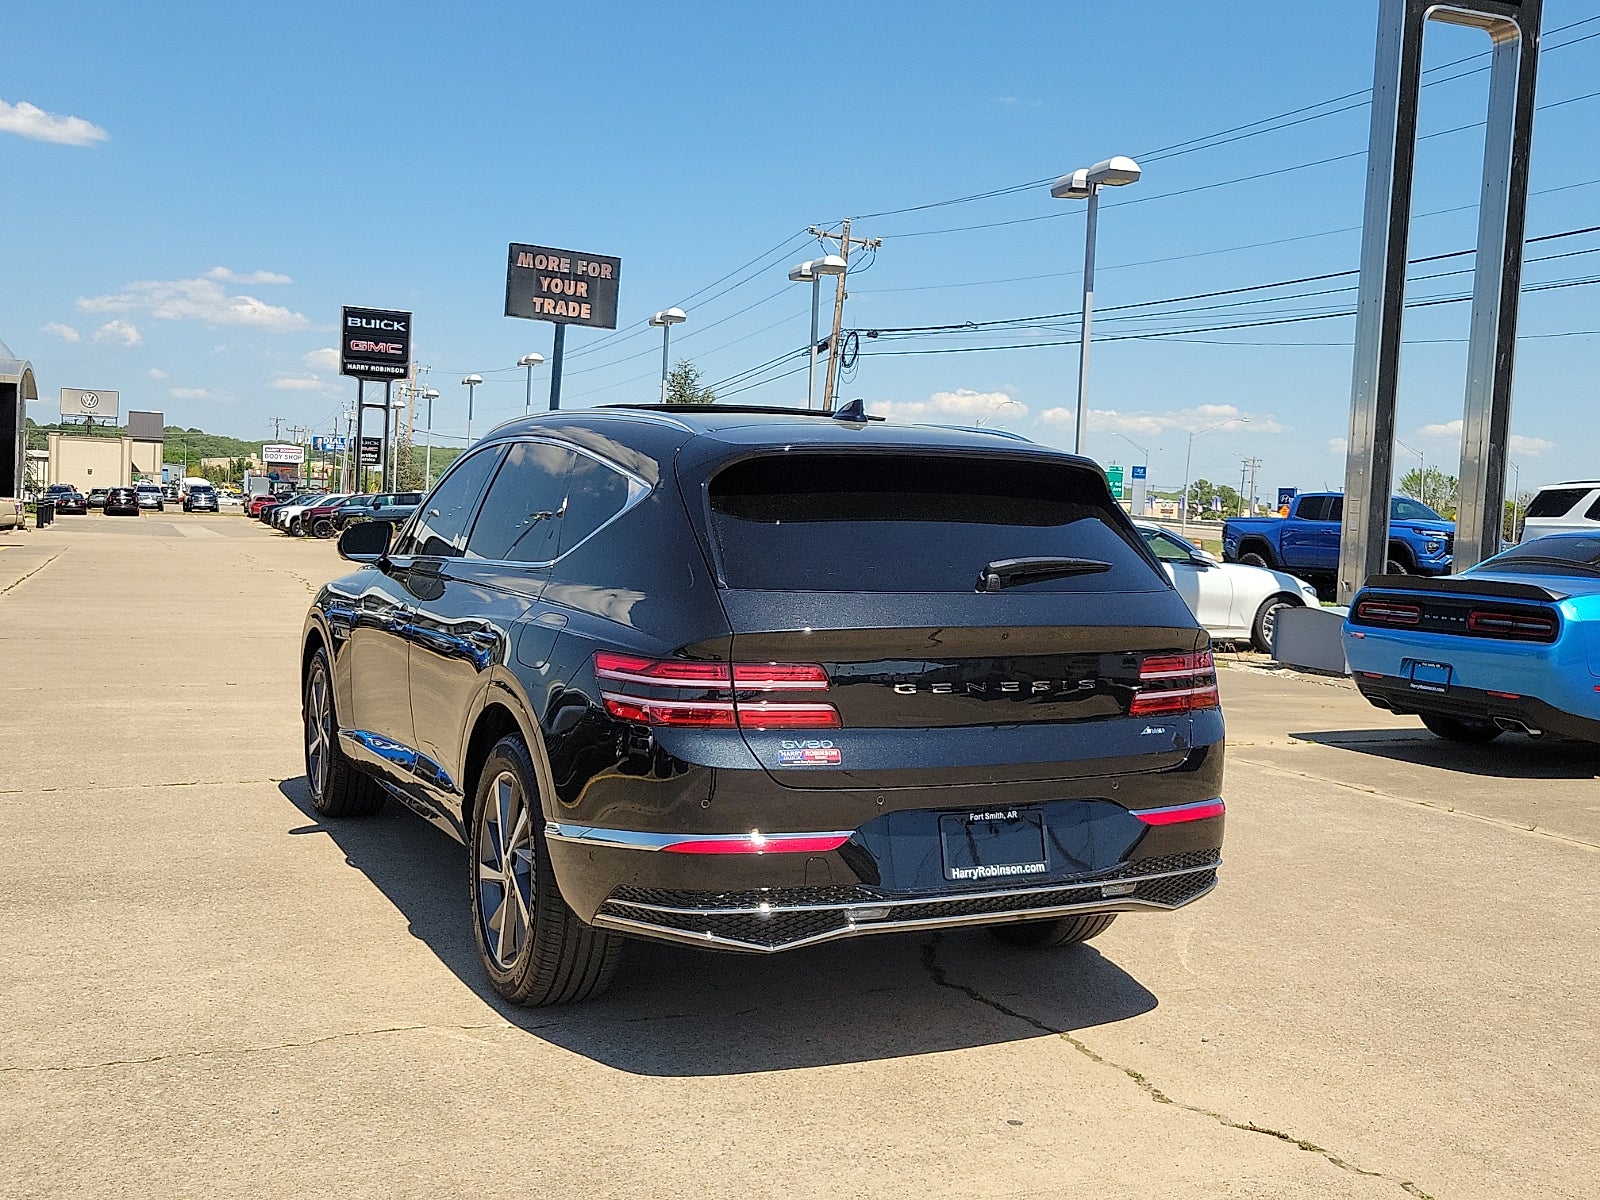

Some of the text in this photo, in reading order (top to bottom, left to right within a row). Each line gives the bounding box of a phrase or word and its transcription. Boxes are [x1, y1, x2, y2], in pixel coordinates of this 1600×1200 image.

[517, 252, 612, 279] MORE FOR
[540, 276, 587, 297] YOUR
[533, 297, 591, 319] TRADE
[347, 317, 407, 331] BUICK
[350, 340, 403, 355] GMC
[347, 363, 405, 374] HARRY ROBINSON
[893, 679, 1096, 695] GENESIS
[781, 739, 834, 749] GV80
[969, 810, 1018, 821] Fort Smith, AR
[951, 863, 1046, 880] HarryRobinson.com
